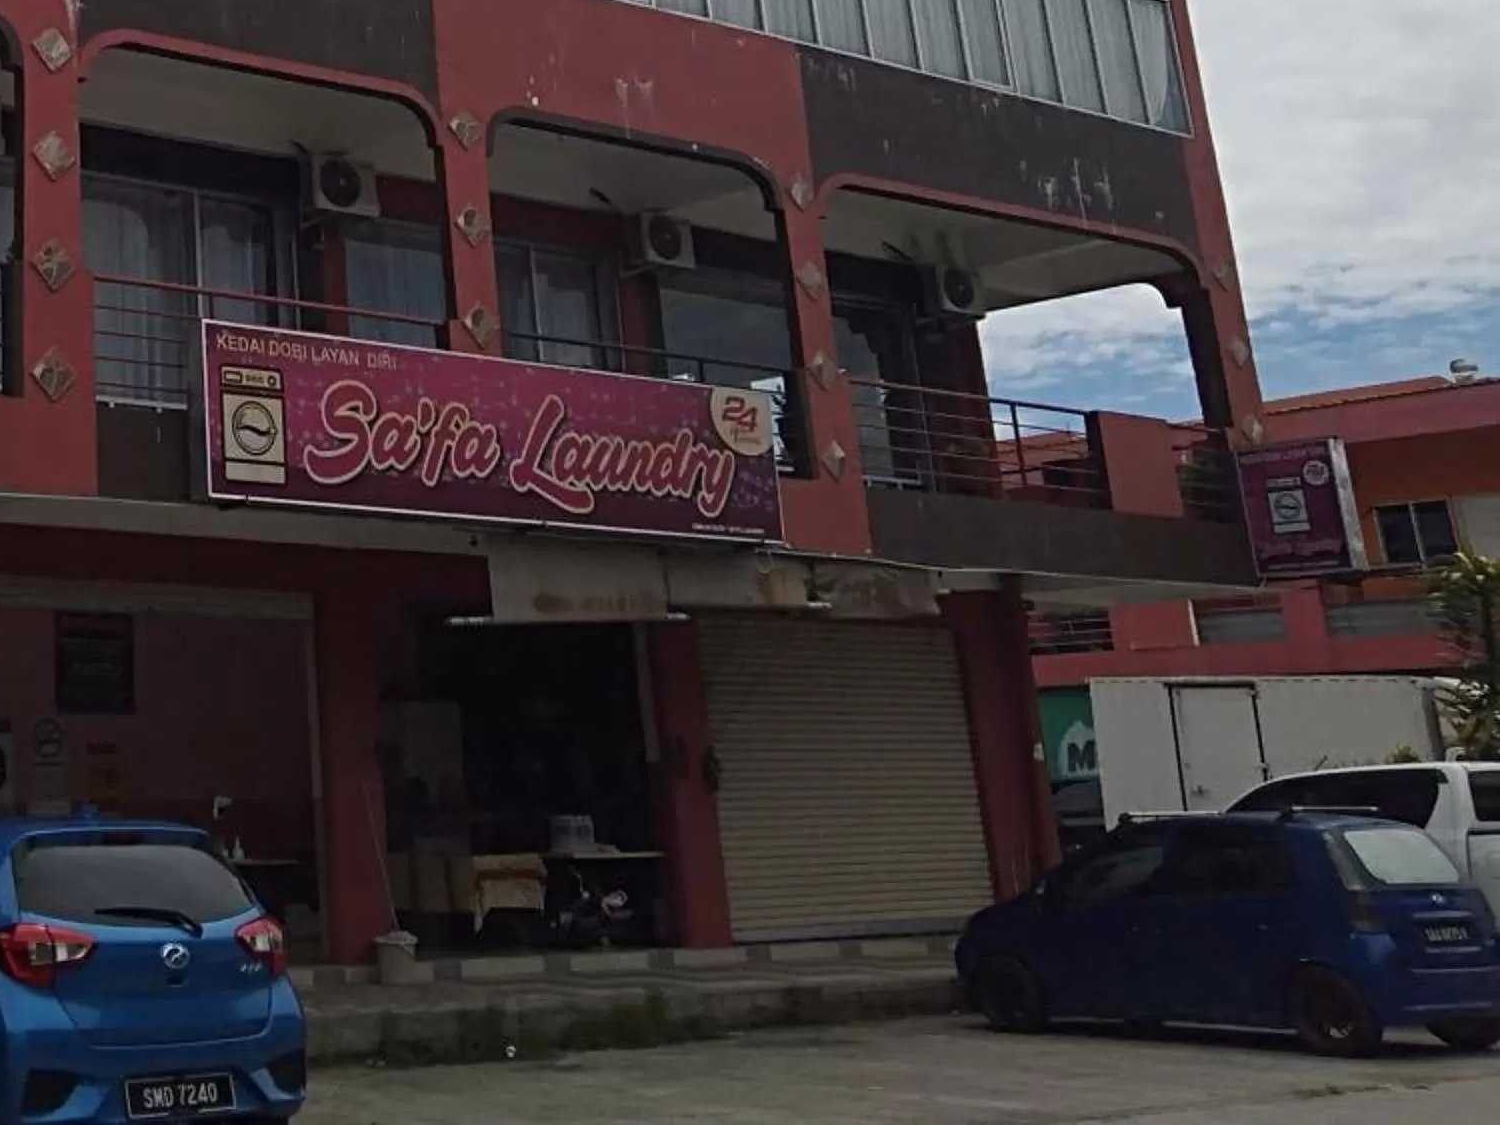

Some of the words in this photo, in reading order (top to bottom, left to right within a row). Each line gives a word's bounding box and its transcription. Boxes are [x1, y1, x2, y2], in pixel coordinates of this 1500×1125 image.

[216, 333, 264, 354] KEDAI
[270, 340, 308, 361] DOBI
[312, 346, 361, 366] LAYAN
[367, 352, 397, 370] DIRI
[722, 396, 758, 432] 24
[304, 379, 500, 487] Sa'fa
[510, 395, 737, 518] Laundry
[143, 1087, 175, 1108] SMD
[177, 1082, 218, 1106] 7240
